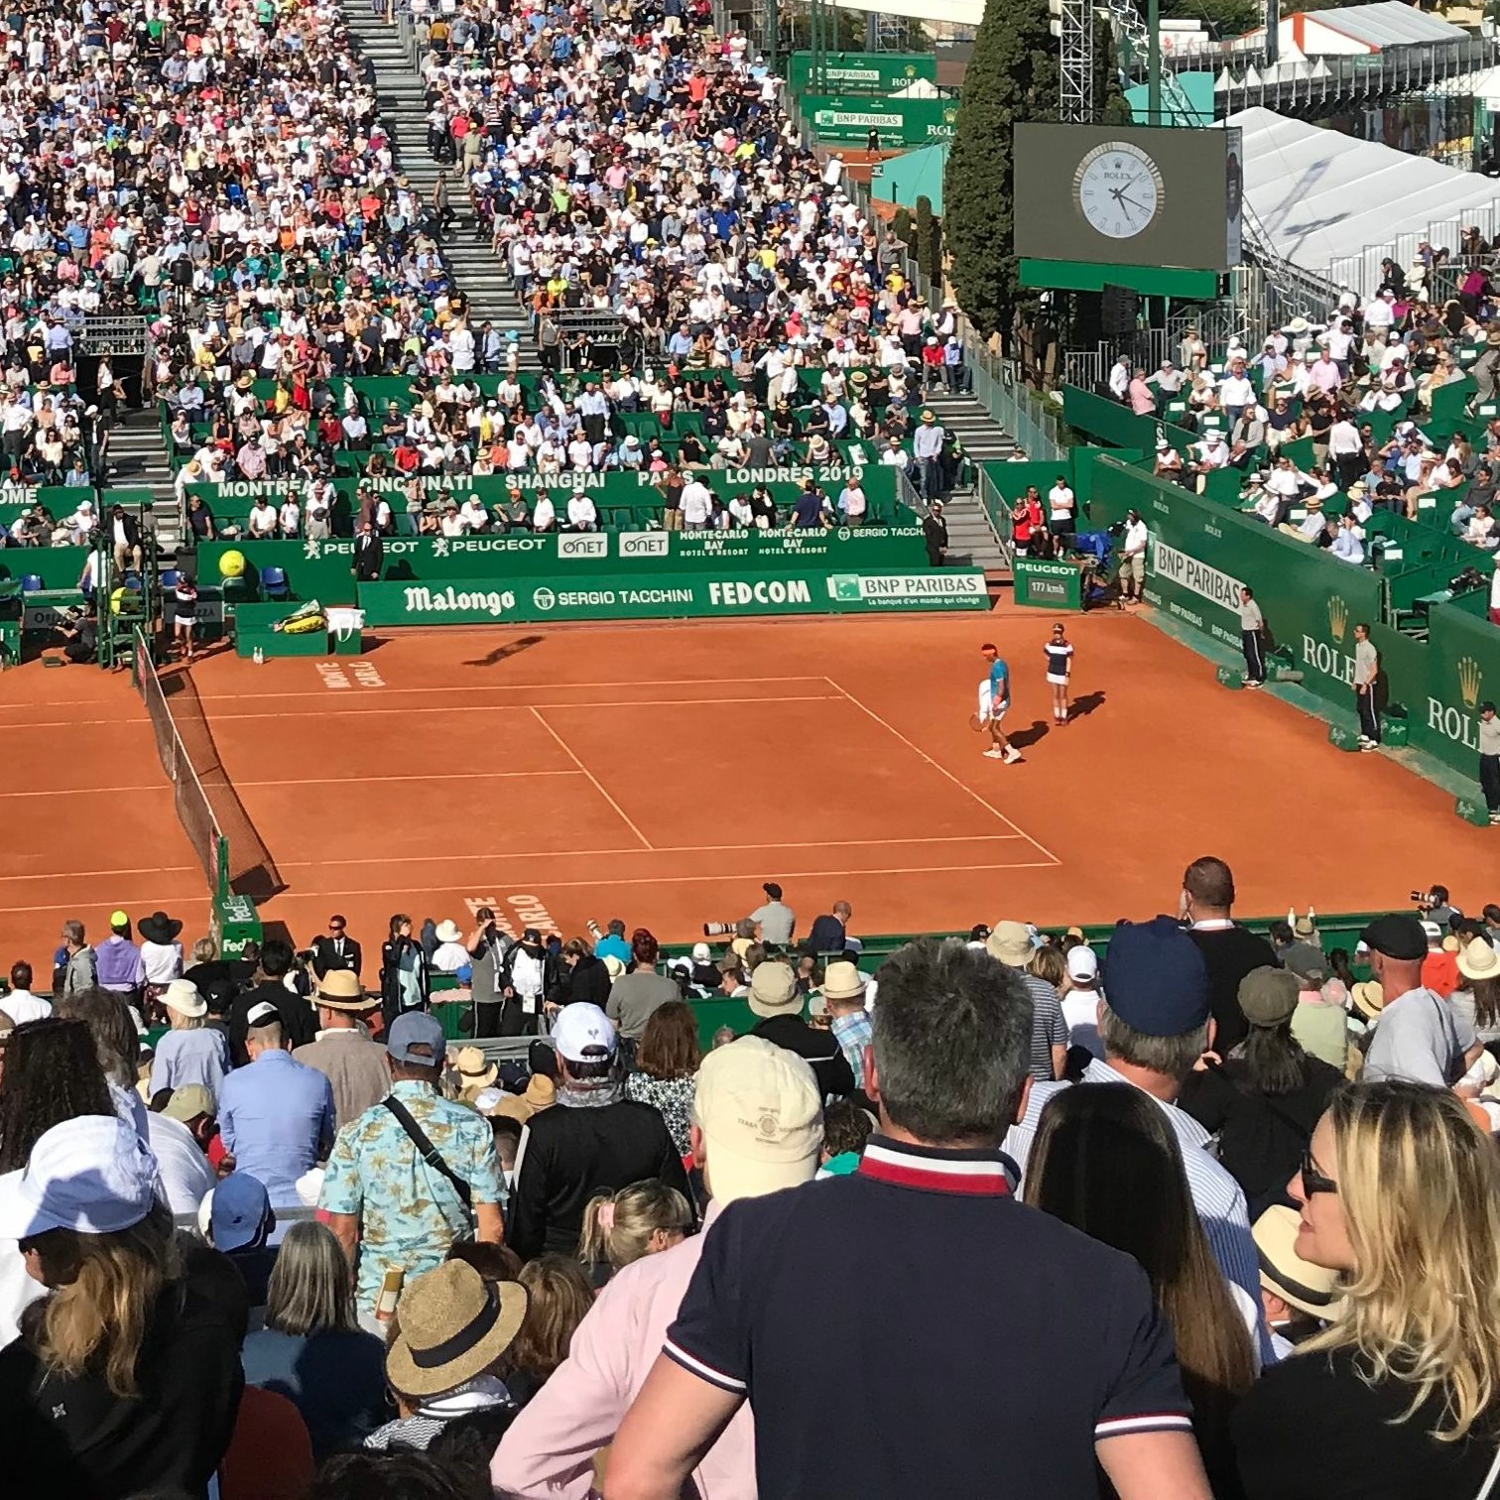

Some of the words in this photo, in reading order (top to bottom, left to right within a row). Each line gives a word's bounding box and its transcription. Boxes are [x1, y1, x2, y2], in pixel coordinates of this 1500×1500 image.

[844, 71, 876, 79] PARIBAS
[837, 114, 855, 124] BNP
[858, 115, 899, 125] PARIBAS
[927, 124, 956, 136] ROL
[1104, 172, 1132, 180] ROLEX
[505, 472, 605, 490] SHANGHAI
[638, 470, 694, 486] PAS
[726, 467, 814, 483] LONDRES
[819, 466, 864, 481] 2019
[359, 475, 473, 493] CINCNATI
[853, 528, 889, 538] SERGIO
[324, 542, 419, 555] PEUEOT
[452, 539, 547, 552] PEUGEOT
[704, 541, 724, 550] BAY
[783, 539, 803, 548] BAY
[1016, 562, 1078, 576] PEUGEOT
[1158, 546, 1184, 578] BNP
[1186, 560, 1241, 609] PARIBAS
[708, 580, 811, 605] FEDCOM
[865, 579, 900, 593] BNP
[904, 578, 977, 593] PARIBAS
[404, 586, 515, 616] Malongo
[559, 592, 615, 606] SERGIO
[618, 589, 693, 604] TACCHINI
[1302, 634, 1356, 687] ROLE
[1427, 696, 1483, 753] ROL
[223, 938, 261, 952] Fed
